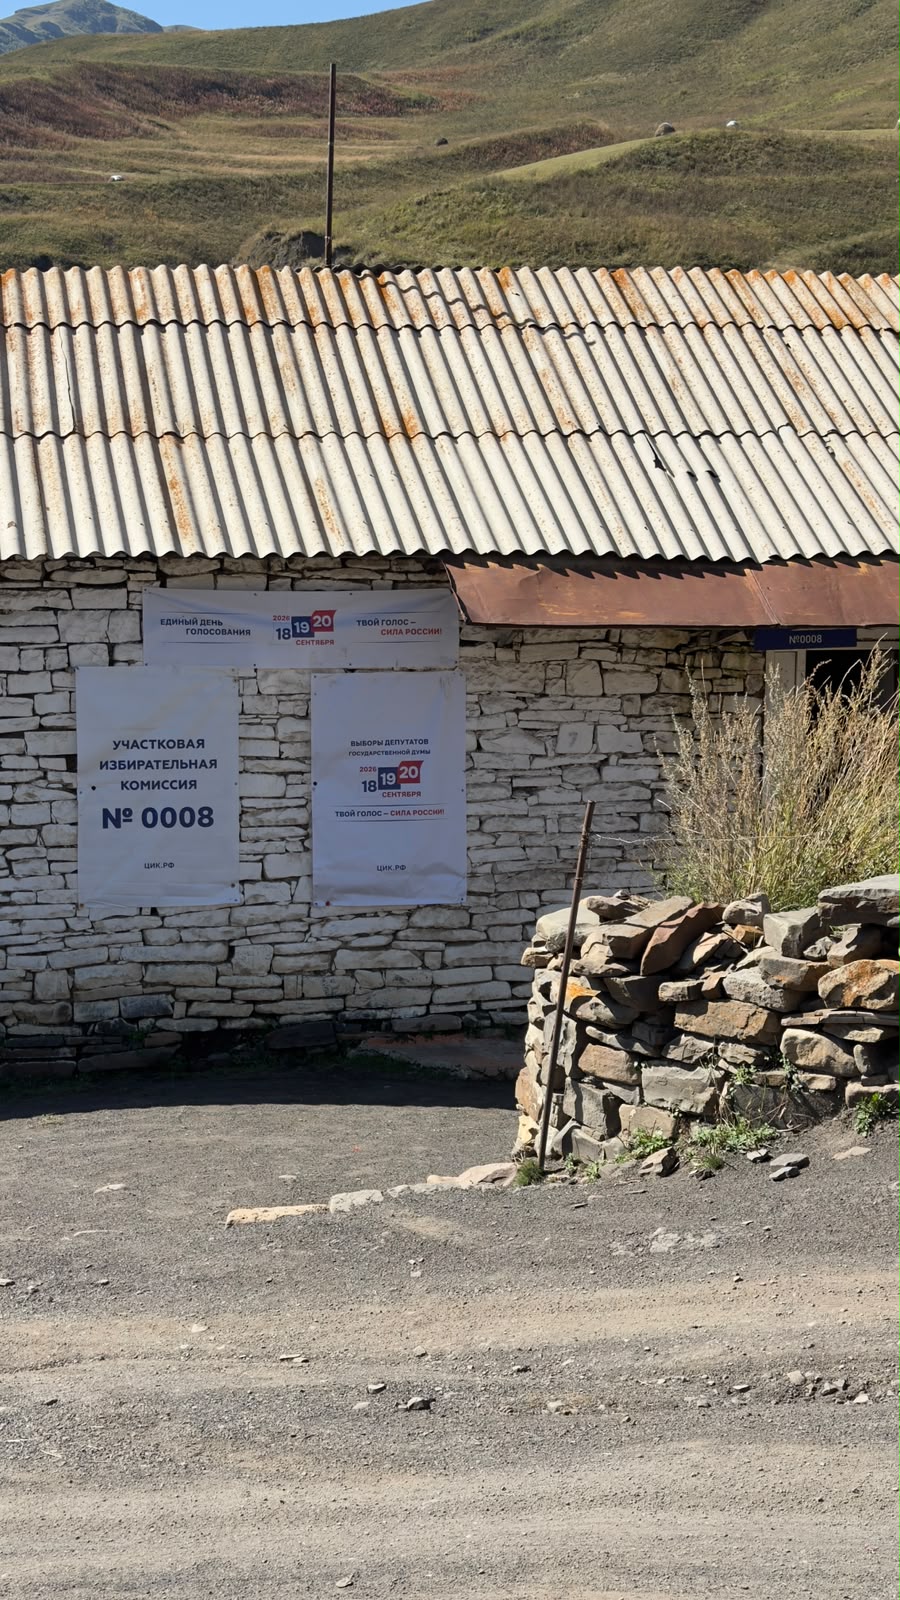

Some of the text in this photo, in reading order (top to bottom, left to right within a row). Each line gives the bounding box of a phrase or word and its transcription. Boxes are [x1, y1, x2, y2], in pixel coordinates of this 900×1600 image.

[160, 618, 199, 626] ЕДИНЫЙ
[356, 618, 379, 626] ТВОЙ
[186, 628, 251, 636] ГОЛОСОВАНИЯ
[276, 616, 332, 640] 18 19 20
[789, 634, 822, 644] №0008
[112, 739, 205, 750] УЧАСТКОВАЯ
[100, 759, 218, 770] ИЗБИРАТЕЛЬНАЯ
[362, 766, 418, 792] 18 19 20
[121, 780, 197, 790] КОМИССИЯ
[102, 806, 214, 829] № 0008
[335, 810, 356, 818] ТВОЙ
[377, 864, 406, 872] ЦИК.РФ
